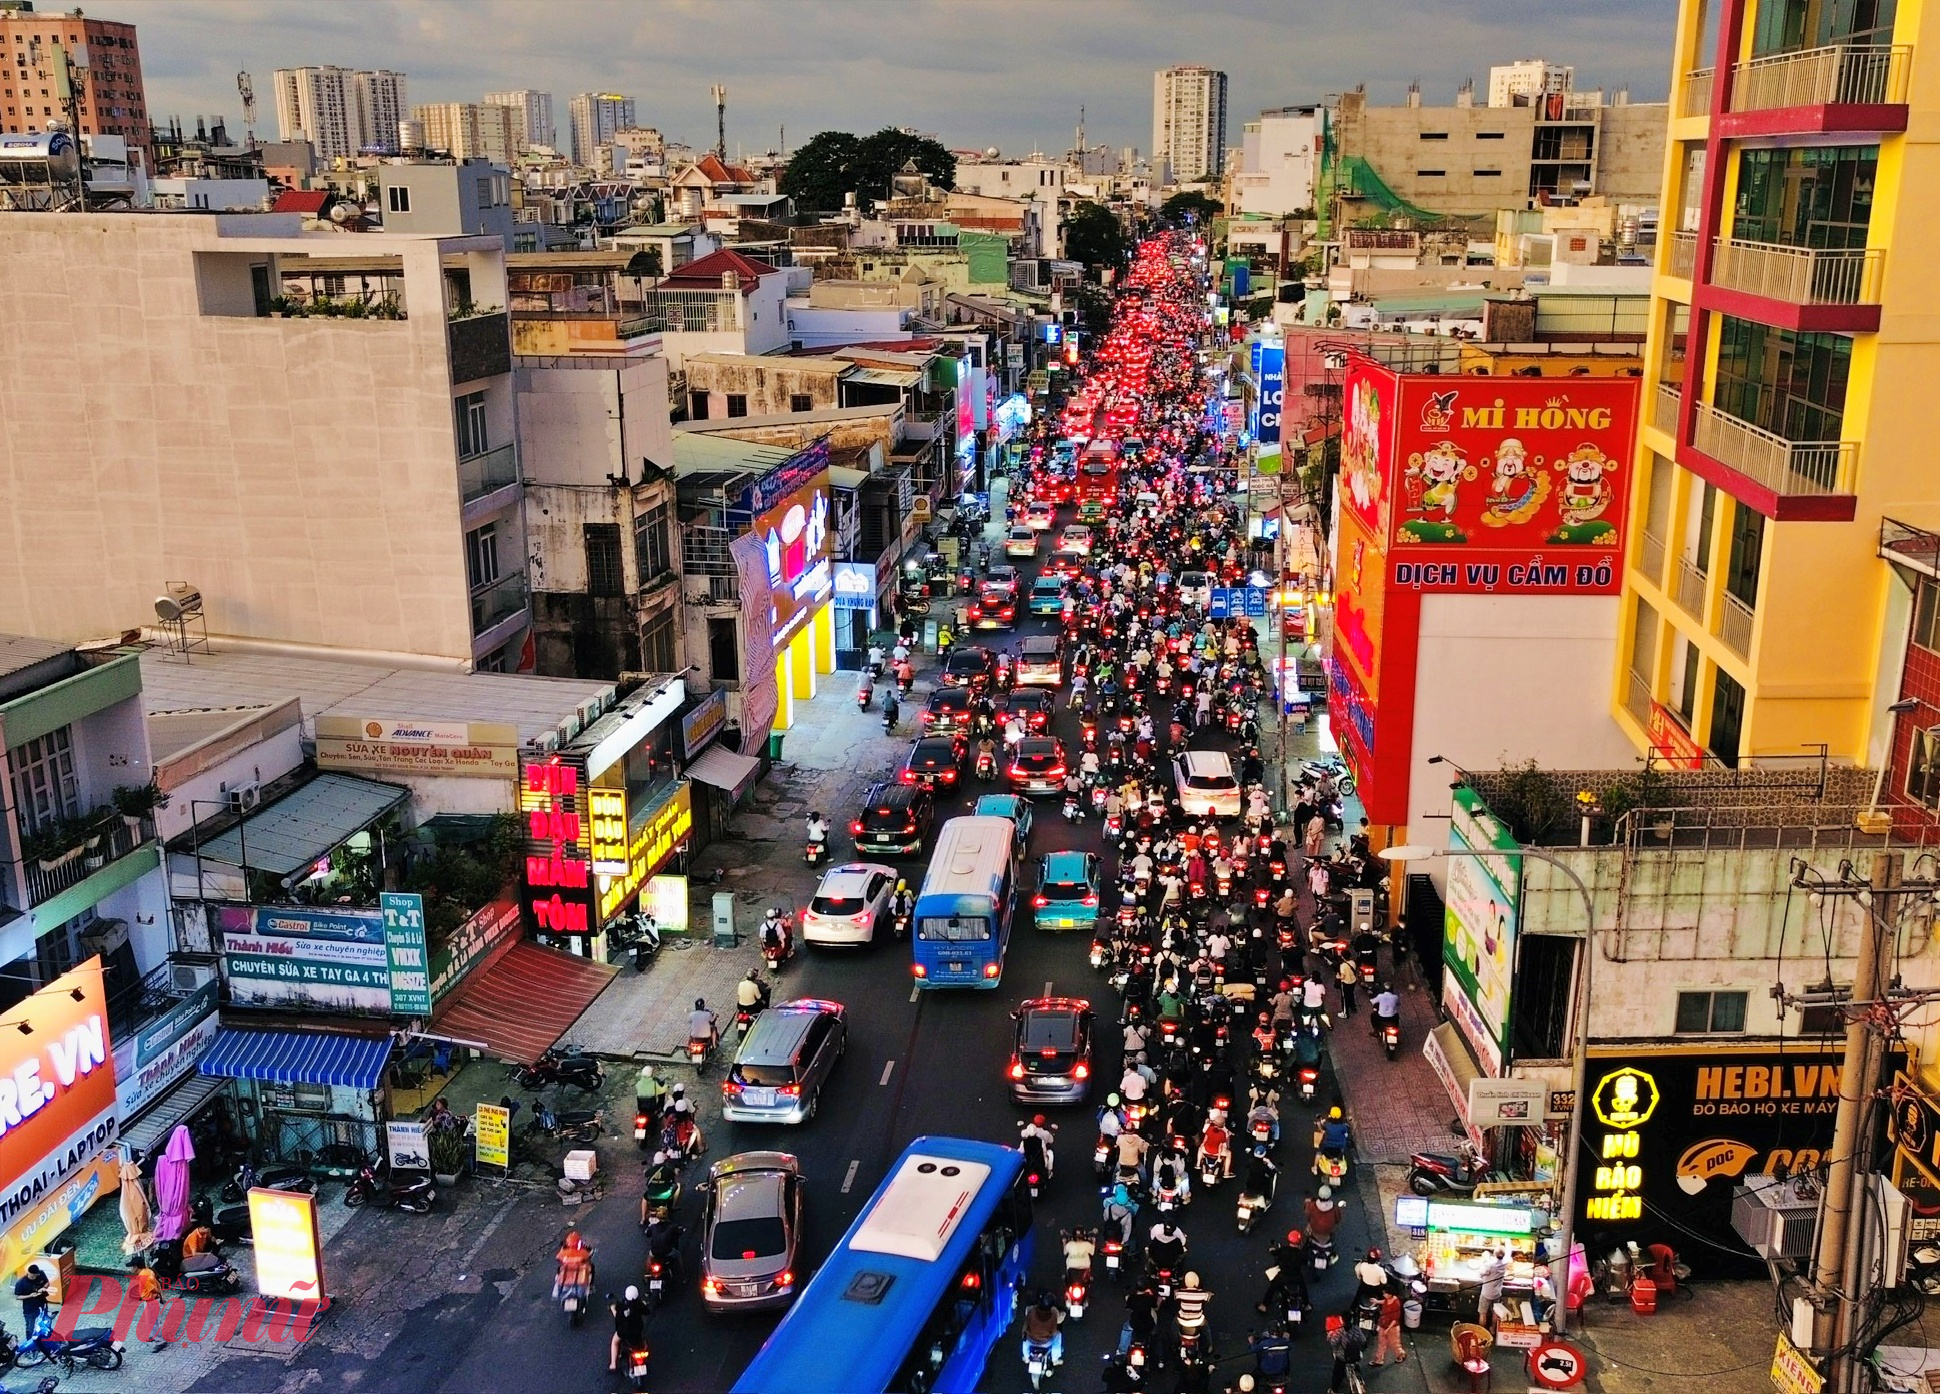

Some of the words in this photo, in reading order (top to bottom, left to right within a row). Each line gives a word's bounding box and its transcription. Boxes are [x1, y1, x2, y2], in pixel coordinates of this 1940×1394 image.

[1395, 562, 1458, 590] DỊCH
[1465, 563, 1501, 592] VỤ
[391, 729, 434, 738] ADVANCE
[372, 745, 387, 754] XE
[490, 760, 503, 768] Tay
[526, 757, 578, 796] BÚN
[591, 793, 623, 817] BÚN
[530, 802, 581, 846] ĐẬU
[526, 845, 589, 888] MẮM
[601, 880, 625, 919] BÚN
[671, 808, 692, 843] TÔM
[389, 896, 414, 909] Shop
[532, 893, 589, 931] TÔM
[277, 920, 310, 932] Castrol
[312, 921, 328, 930] Bike
[328, 923, 347, 931] Point
[384, 908, 421, 928] T&T
[479, 907, 495, 930] Shop
[226, 938, 263, 953] Thành
[295, 940, 311, 950] Sửa
[325, 943, 355, 954] chuyên
[356, 947, 386, 957] nghiệp
[232, 960, 276, 976] CHUYÊN
[278, 960, 300, 977] SỬA
[303, 966, 317, 979] XE
[321, 968, 342, 981] TAY
[345, 969, 360, 983] GA
[362, 970, 370, 983] 4
[408, 994, 426, 1003] XVNT
[137, 1050, 175, 1087] Thành
[144, 1079, 154, 1093] xe
[1695, 1064, 1843, 1100] HEBI.VN
[1552, 1093, 1576, 1106] 332
[1553, 1104, 1574, 1112] XVNT
[1754, 1101, 1777, 1118] HỘ
[1781, 1102, 1800, 1114] XE
[1803, 1100, 1837, 1114] MÁY
[389, 1124, 410, 1134] THÀNH
[0, 1170, 48, 1224] THOẠI
[56, 1115, 116, 1177] LAPTOP
[1706, 1149, 1735, 1172] POC
[1595, 1161, 1643, 1191] BẢO
[1586, 1189, 1643, 1220] HIỂM
